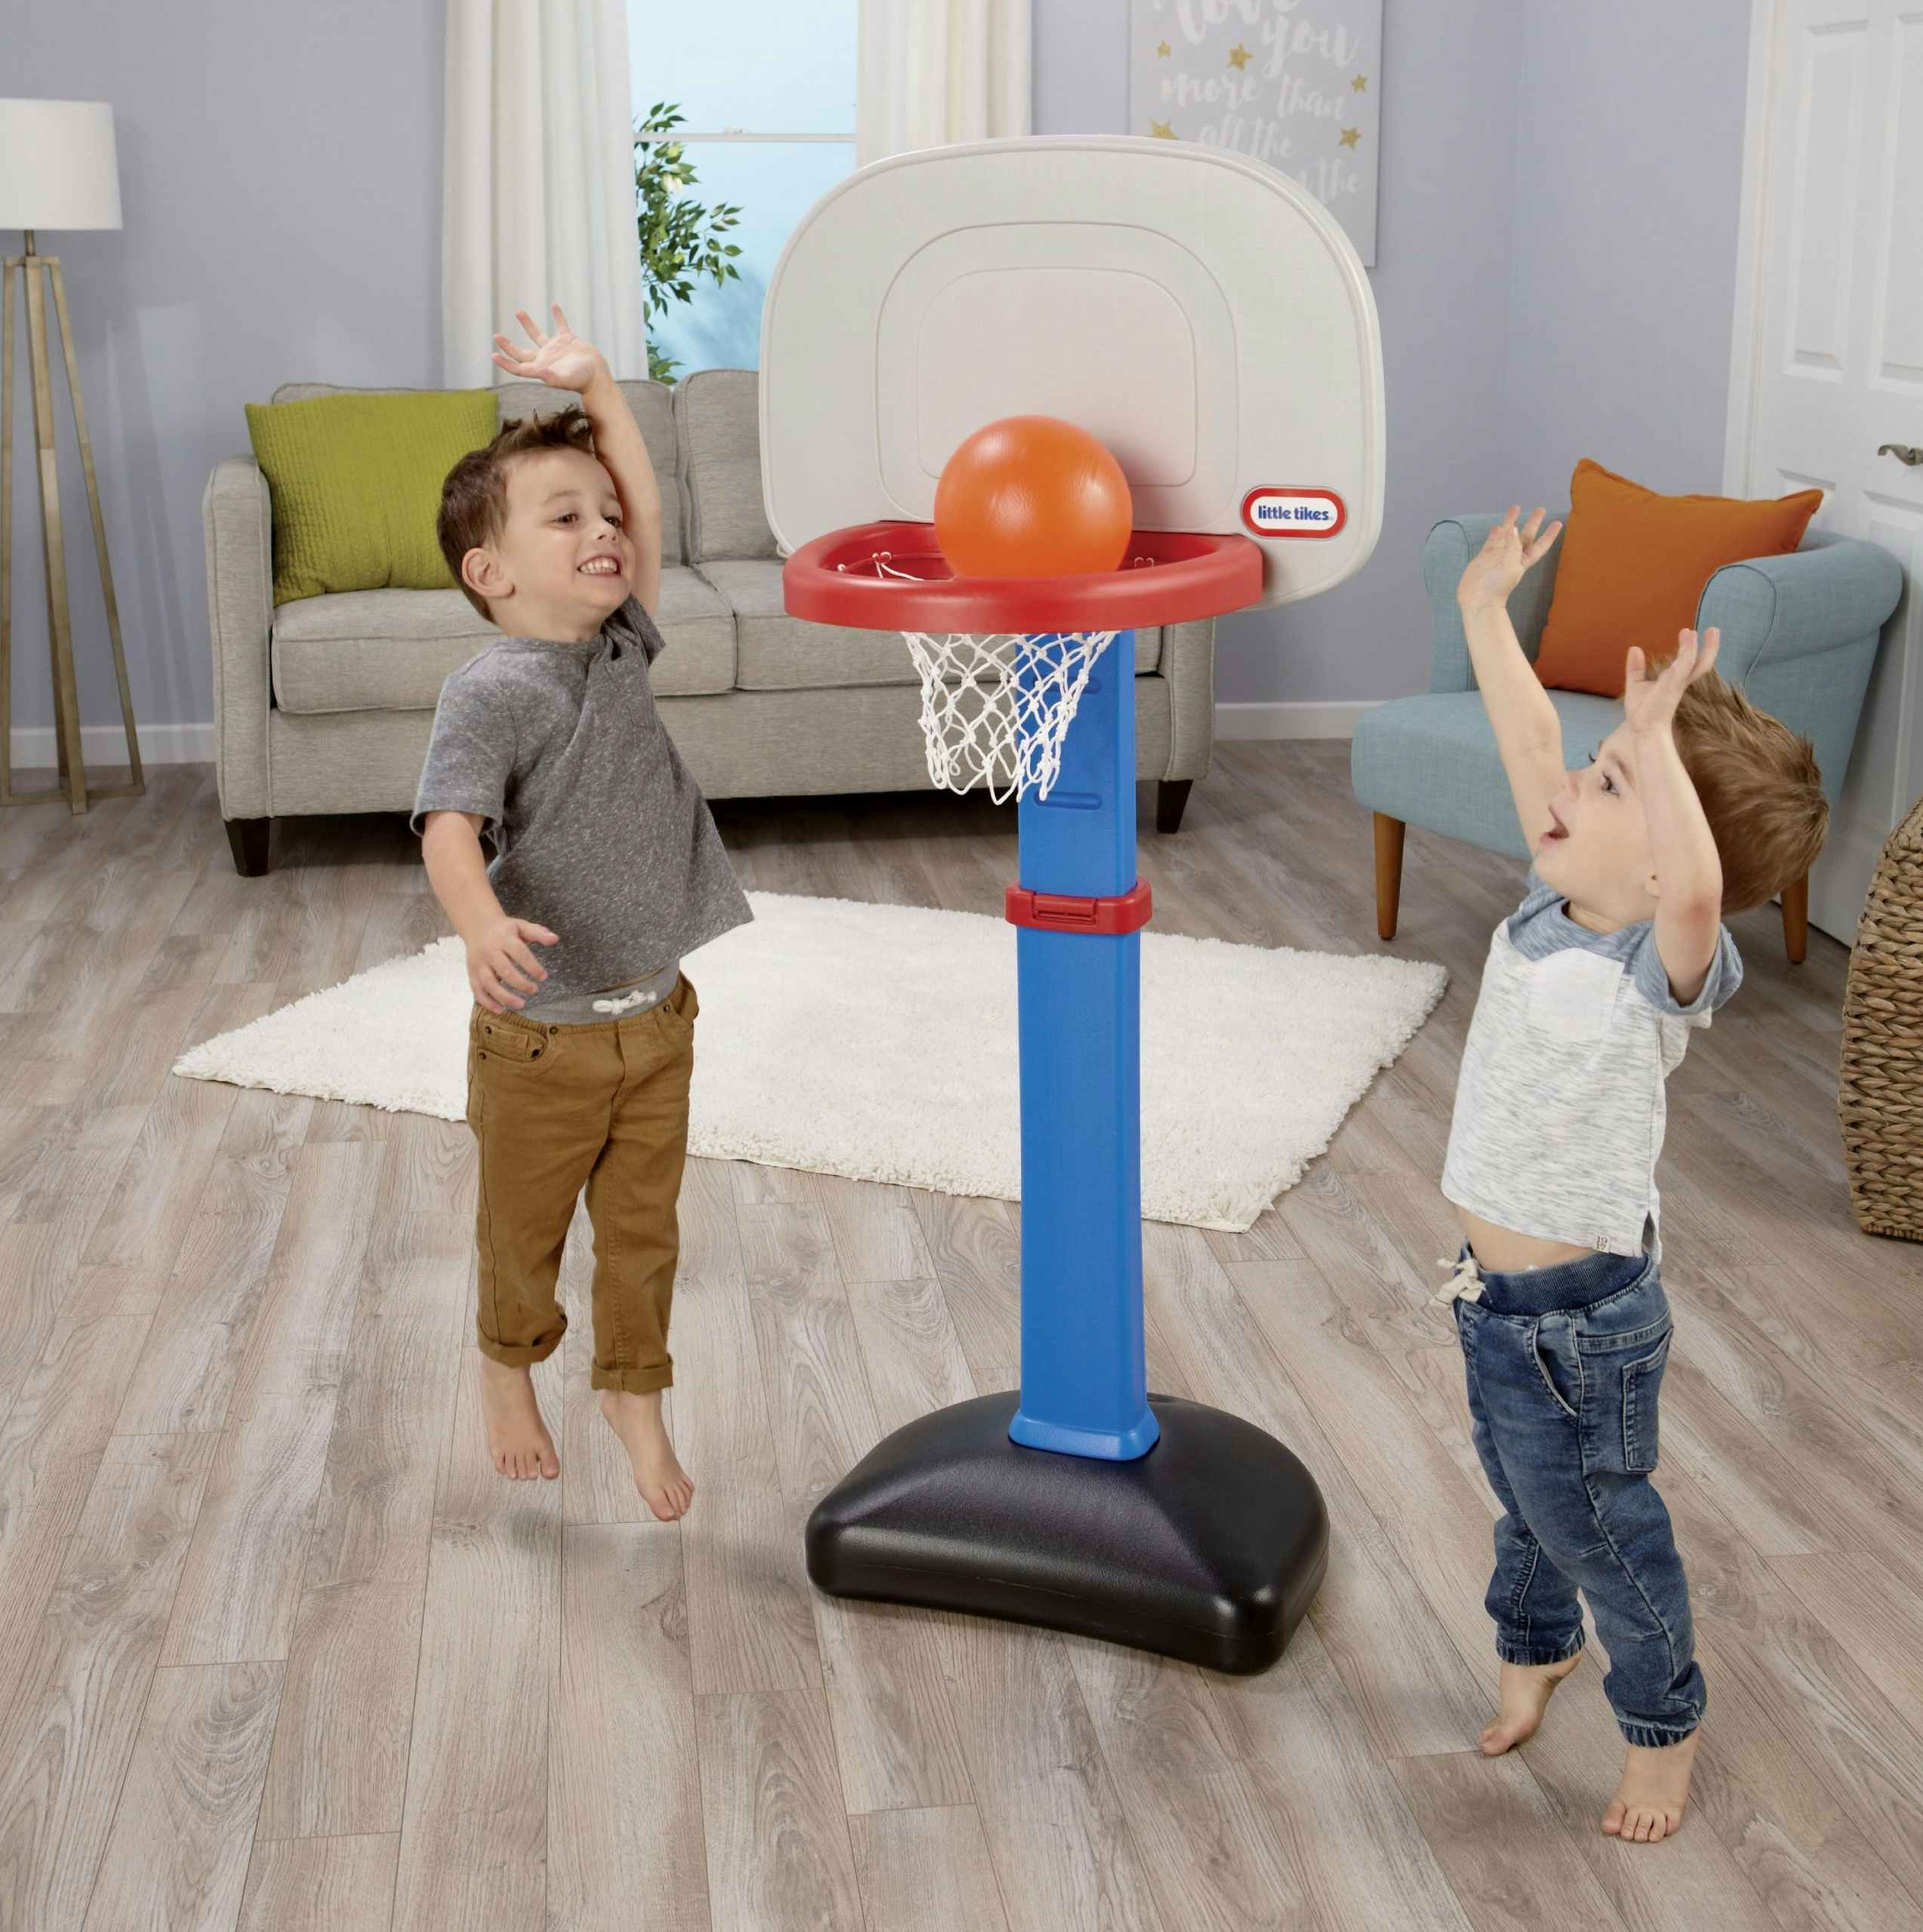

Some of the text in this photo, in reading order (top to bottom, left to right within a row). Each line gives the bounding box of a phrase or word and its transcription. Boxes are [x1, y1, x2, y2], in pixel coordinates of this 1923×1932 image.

[1262, 13, 1359, 78] you
[1159, 72, 1347, 121] more than
[1250, 115, 1294, 159] the
[1258, 505, 1329, 521] little tikes
